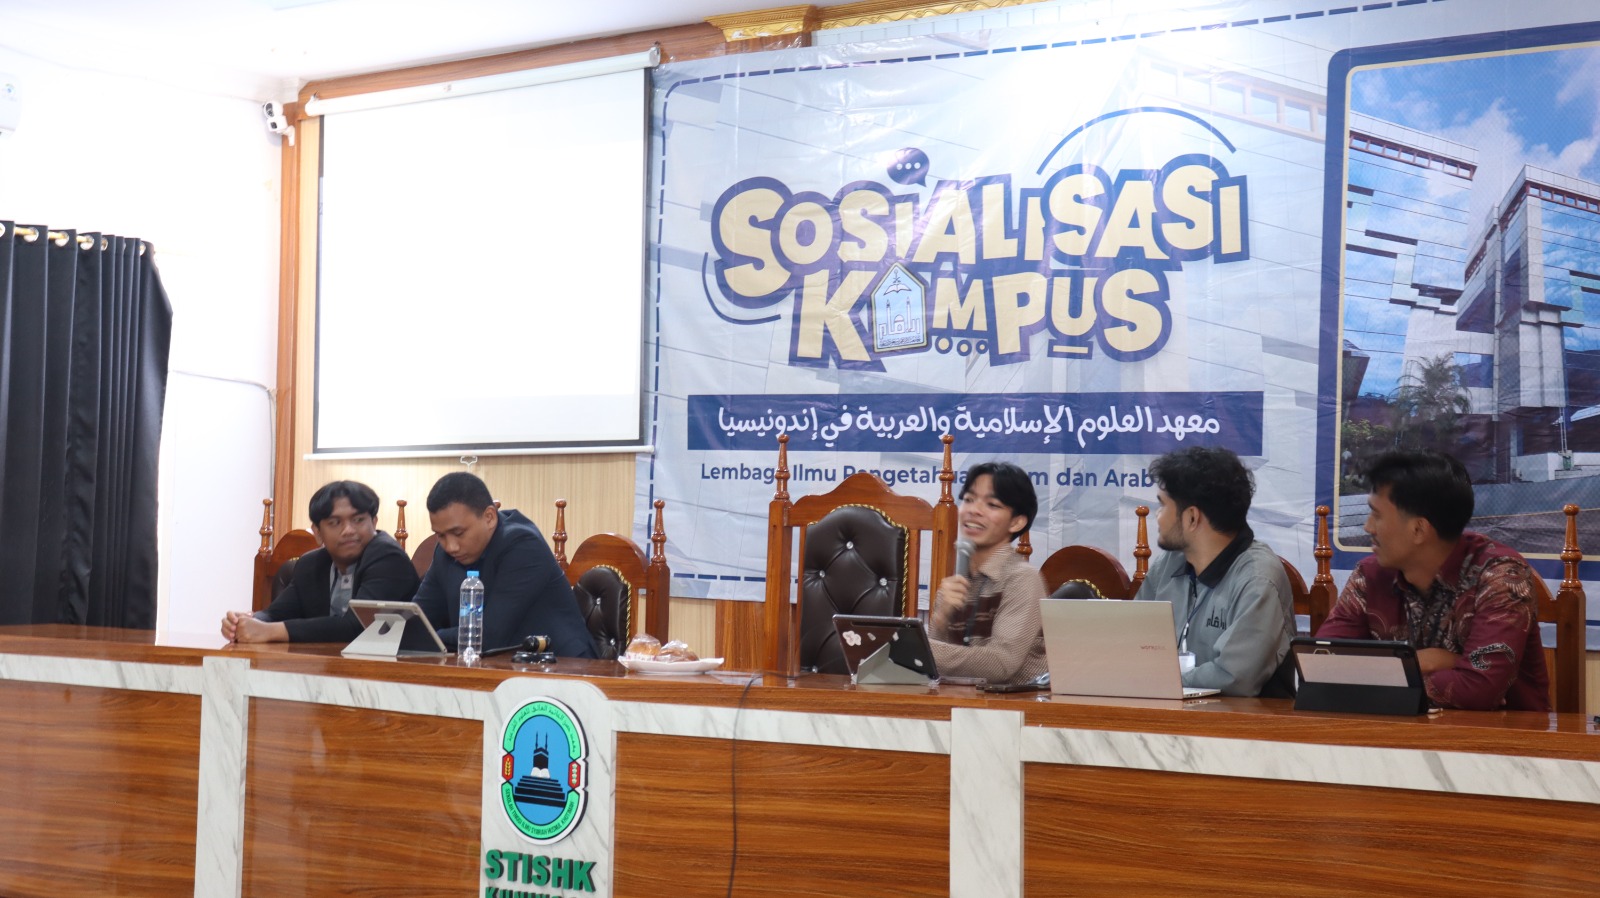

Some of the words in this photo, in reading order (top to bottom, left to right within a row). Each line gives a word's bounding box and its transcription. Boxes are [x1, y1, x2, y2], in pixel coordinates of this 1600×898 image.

[718, 406, 817, 441] إندونيسيا
[820, 404, 853, 448] في
[856, 405, 951, 440] والعربية
[954, 404, 1075, 444] الإسلامية
[1077, 405, 1153, 448] العلوم
[1156, 413, 1221, 441] معهد
[701, 463, 776, 485] Lembag
[793, 464, 836, 482] Ilmu
[1056, 467, 1097, 487] dan
[1103, 468, 1154, 488] Arab
[485, 849, 597, 893] STISHK
